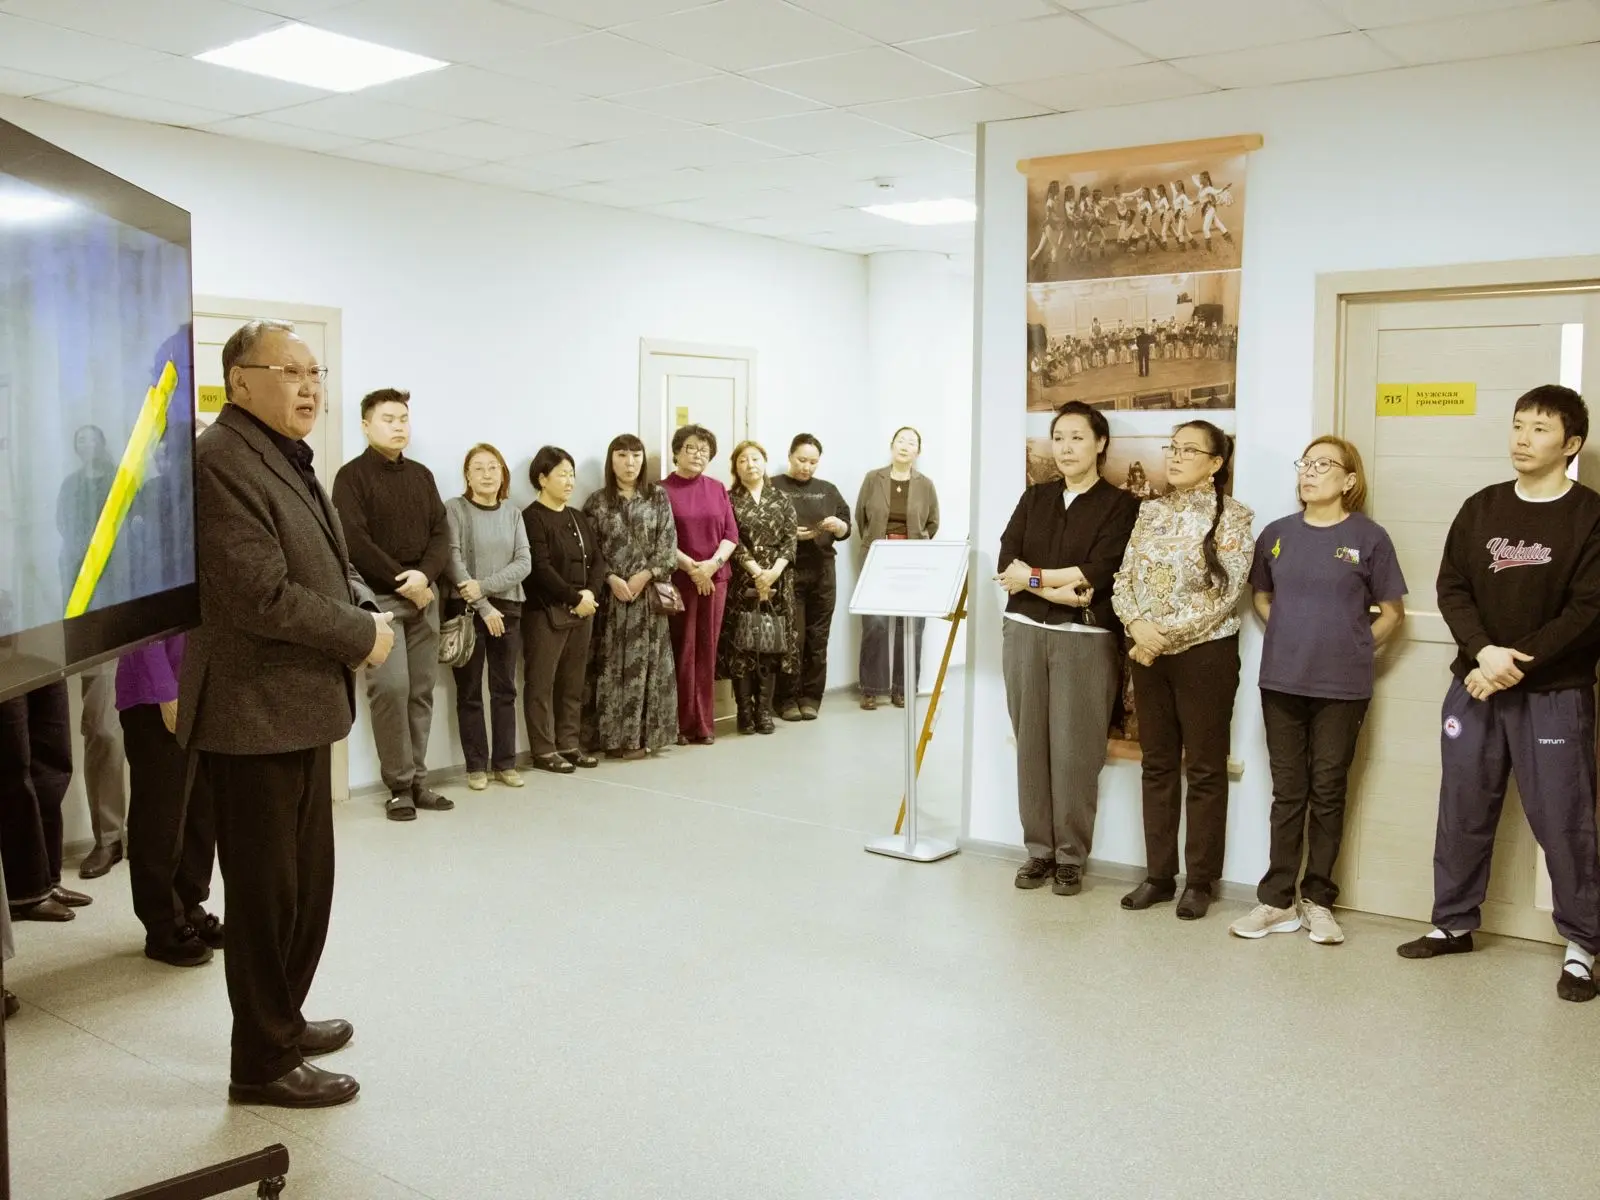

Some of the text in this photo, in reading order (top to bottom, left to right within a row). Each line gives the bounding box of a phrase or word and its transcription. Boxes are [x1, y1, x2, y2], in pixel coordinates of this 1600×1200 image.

[1384, 395, 1401, 404] 515
[1416, 399, 1464, 407] гримерная
[1486, 537, 1552, 561] Yakutia
